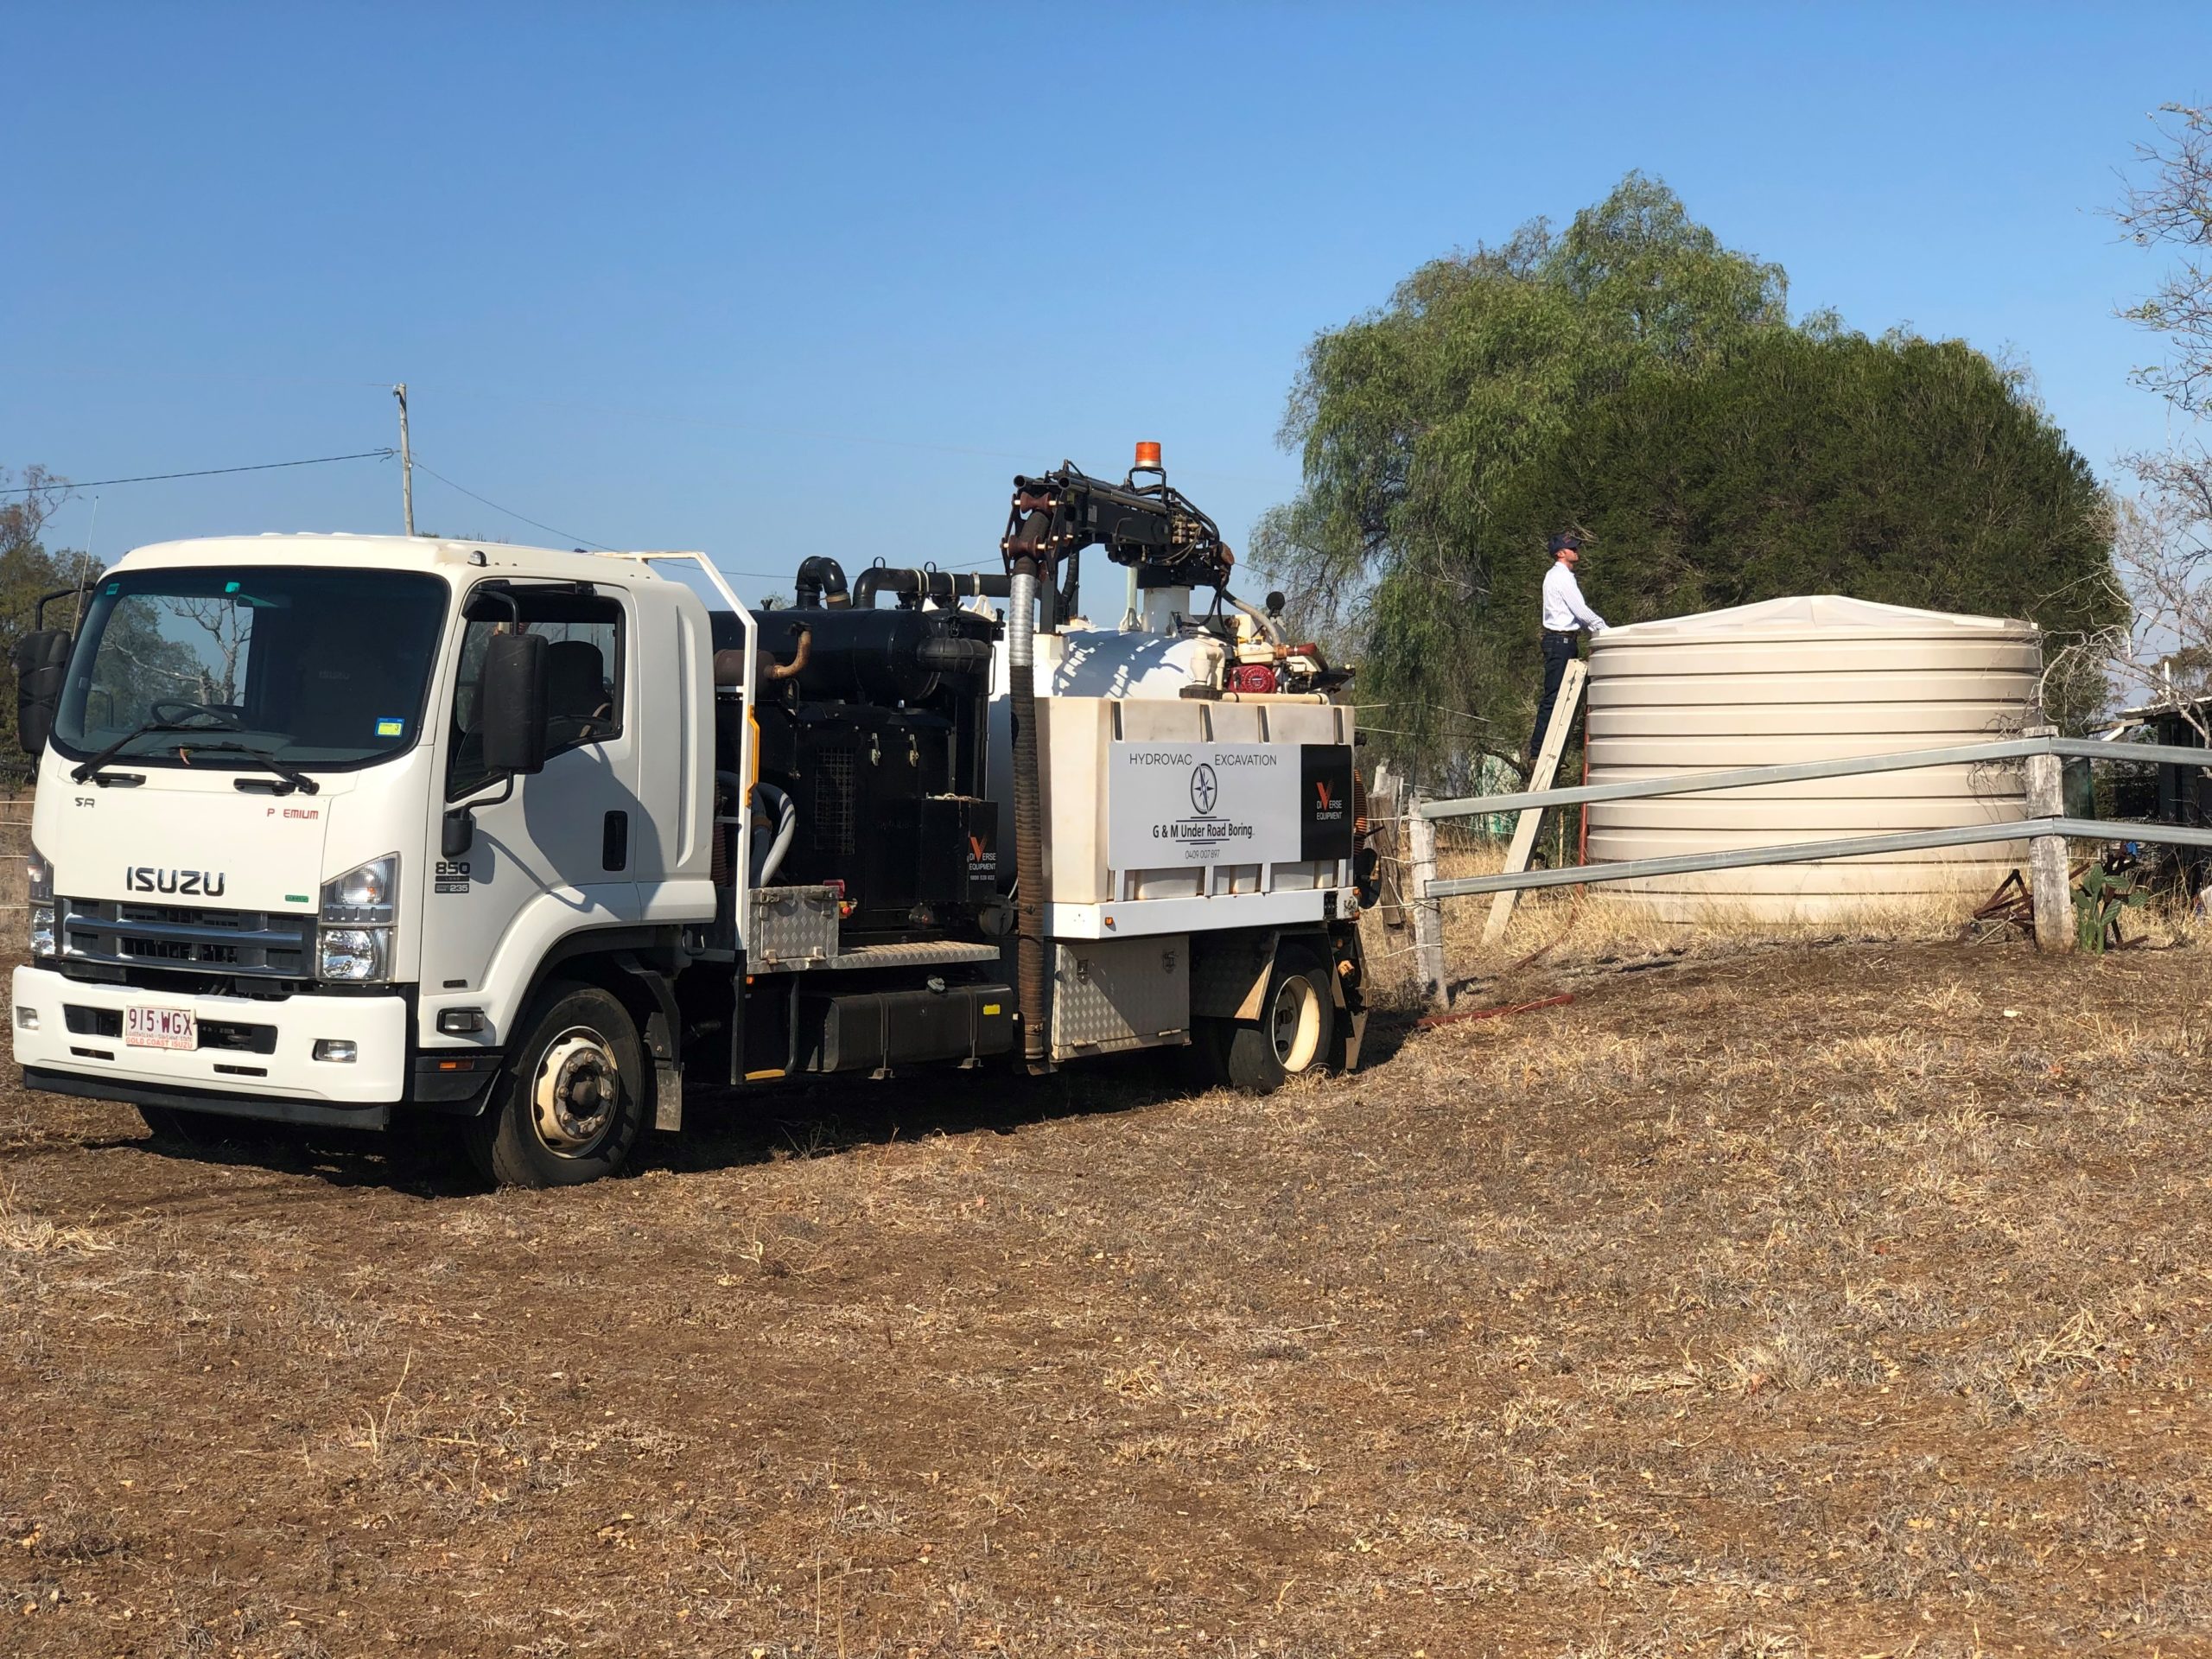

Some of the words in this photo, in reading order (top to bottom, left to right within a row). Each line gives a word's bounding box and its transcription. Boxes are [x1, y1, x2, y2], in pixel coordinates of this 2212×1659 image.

[1129, 753, 1192, 766] HYDROVAC
[1214, 754, 1277, 766] EXCAVATION
[1316, 811, 1342, 821] EQUIPMENT
[1153, 824, 1160, 838] G
[1161, 823, 1167, 838] &
[1170, 824, 1179, 838] M
[1181, 823, 1205, 838] Under
[1208, 823, 1226, 837] Road
[1185, 850, 1199, 859] 0409
[1200, 850, 1210, 859] 007
[1211, 849, 1220, 859] 897
[435, 861, 471, 874] 850
[126, 866, 226, 897] ISUZU
[449, 884, 468, 893] 235
[146, 1039, 168, 1047] COAST
[171, 1040, 193, 1049] ISUZU
